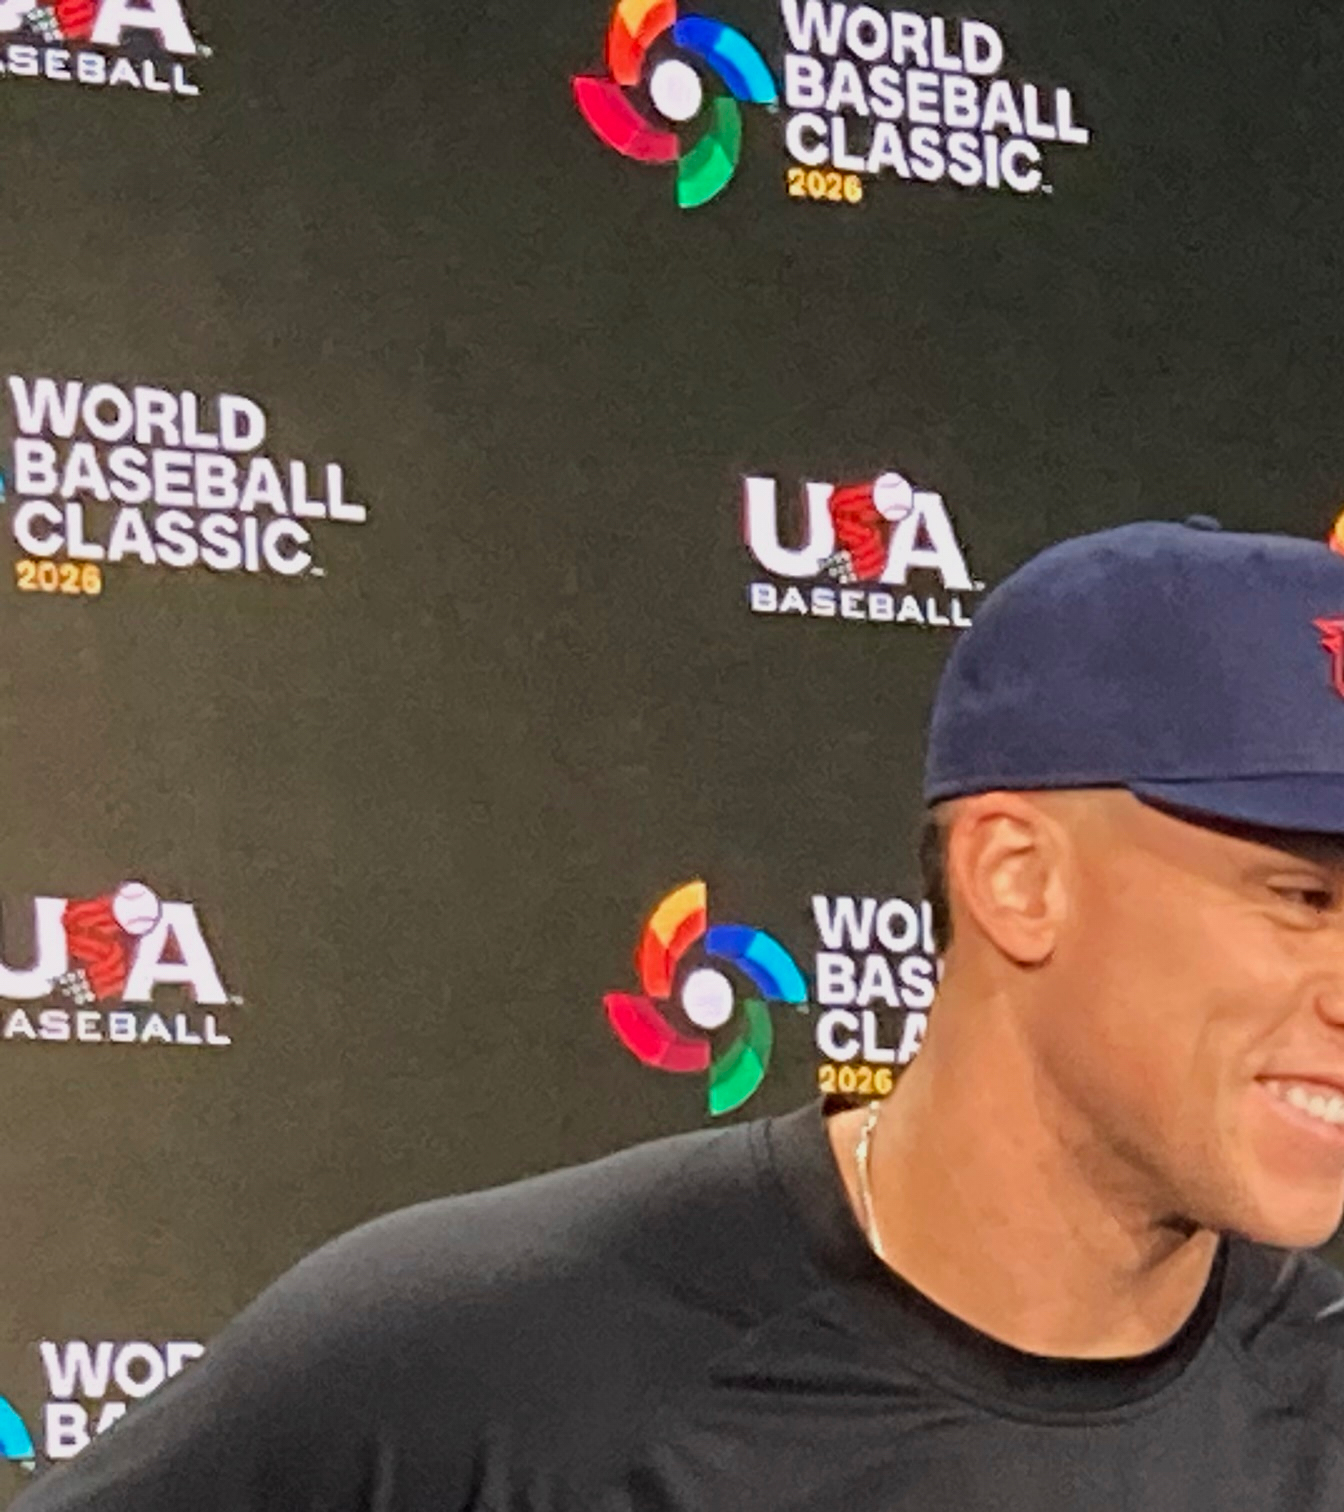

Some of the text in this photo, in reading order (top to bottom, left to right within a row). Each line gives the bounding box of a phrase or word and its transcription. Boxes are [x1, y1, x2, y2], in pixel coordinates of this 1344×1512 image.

[781, 0, 1002, 75] WORLD
[0, 44, 199, 95] SEBALL
[785, 54, 1088, 144] BASEBALL
[786, 112, 1043, 192] CLASSIC
[787, 168, 862, 203] 2026
[8, 375, 267, 451] WORLD
[14, 437, 366, 522] BASEBALL
[13, 500, 312, 575] CLASSIC
[15, 560, 102, 594] 2026
[750, 582, 973, 628] BASEBALL
[4, 1007, 232, 1045] ASEBALL
[818, 1063, 893, 1094] 2026
